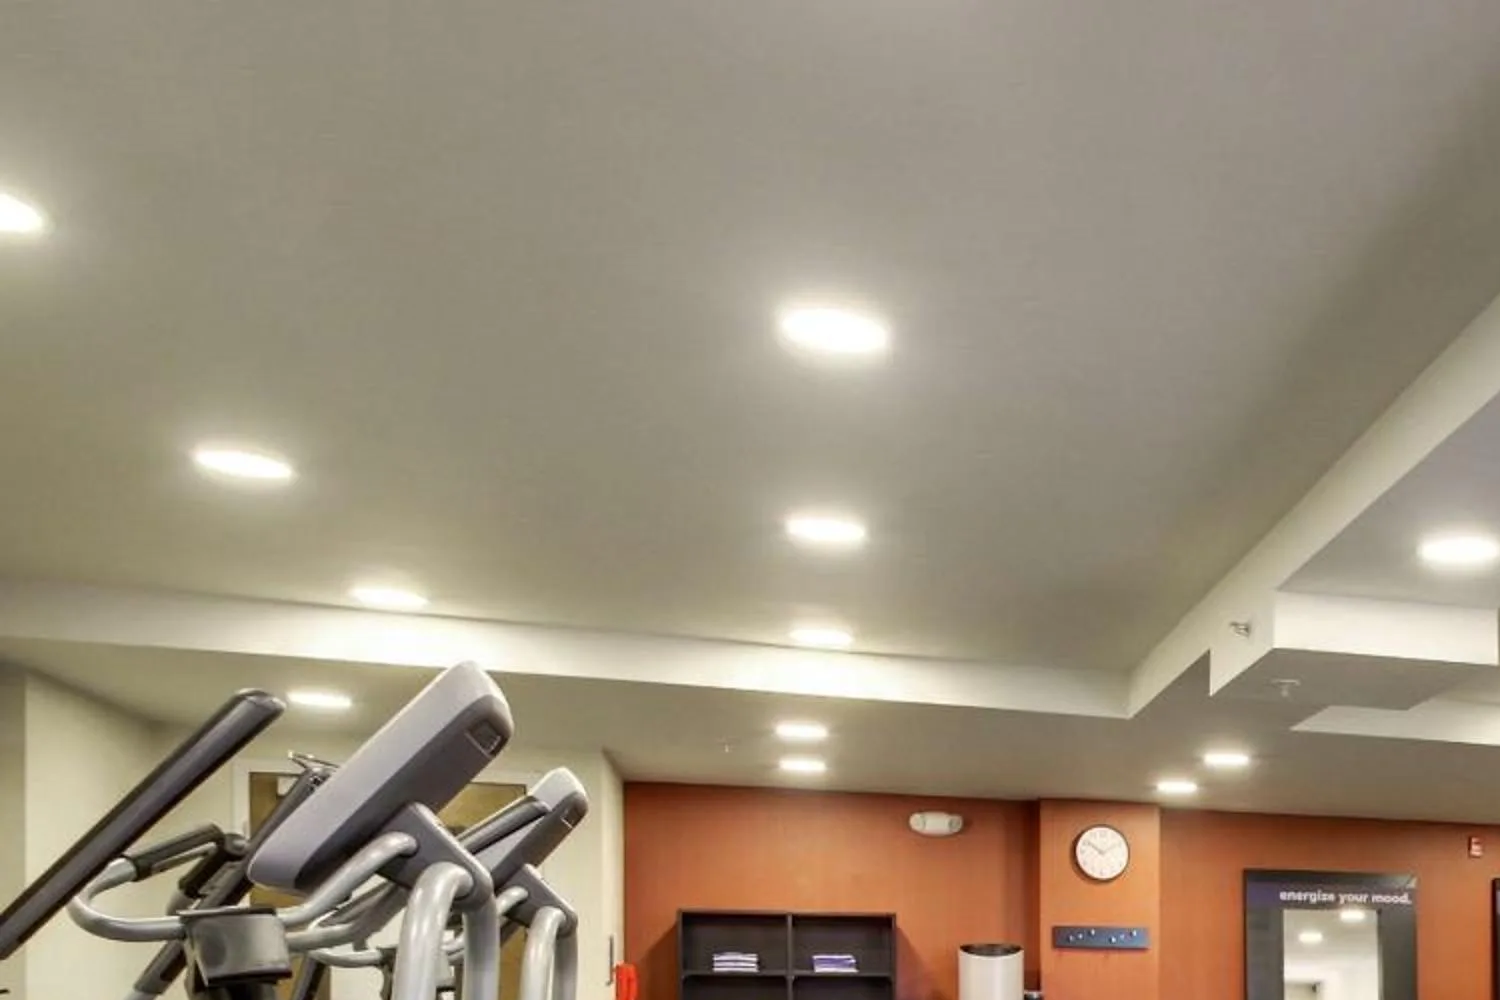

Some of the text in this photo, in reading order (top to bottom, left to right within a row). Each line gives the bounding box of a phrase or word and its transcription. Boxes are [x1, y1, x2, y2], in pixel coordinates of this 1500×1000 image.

[1279, 889, 1412, 904] energize your mood.
